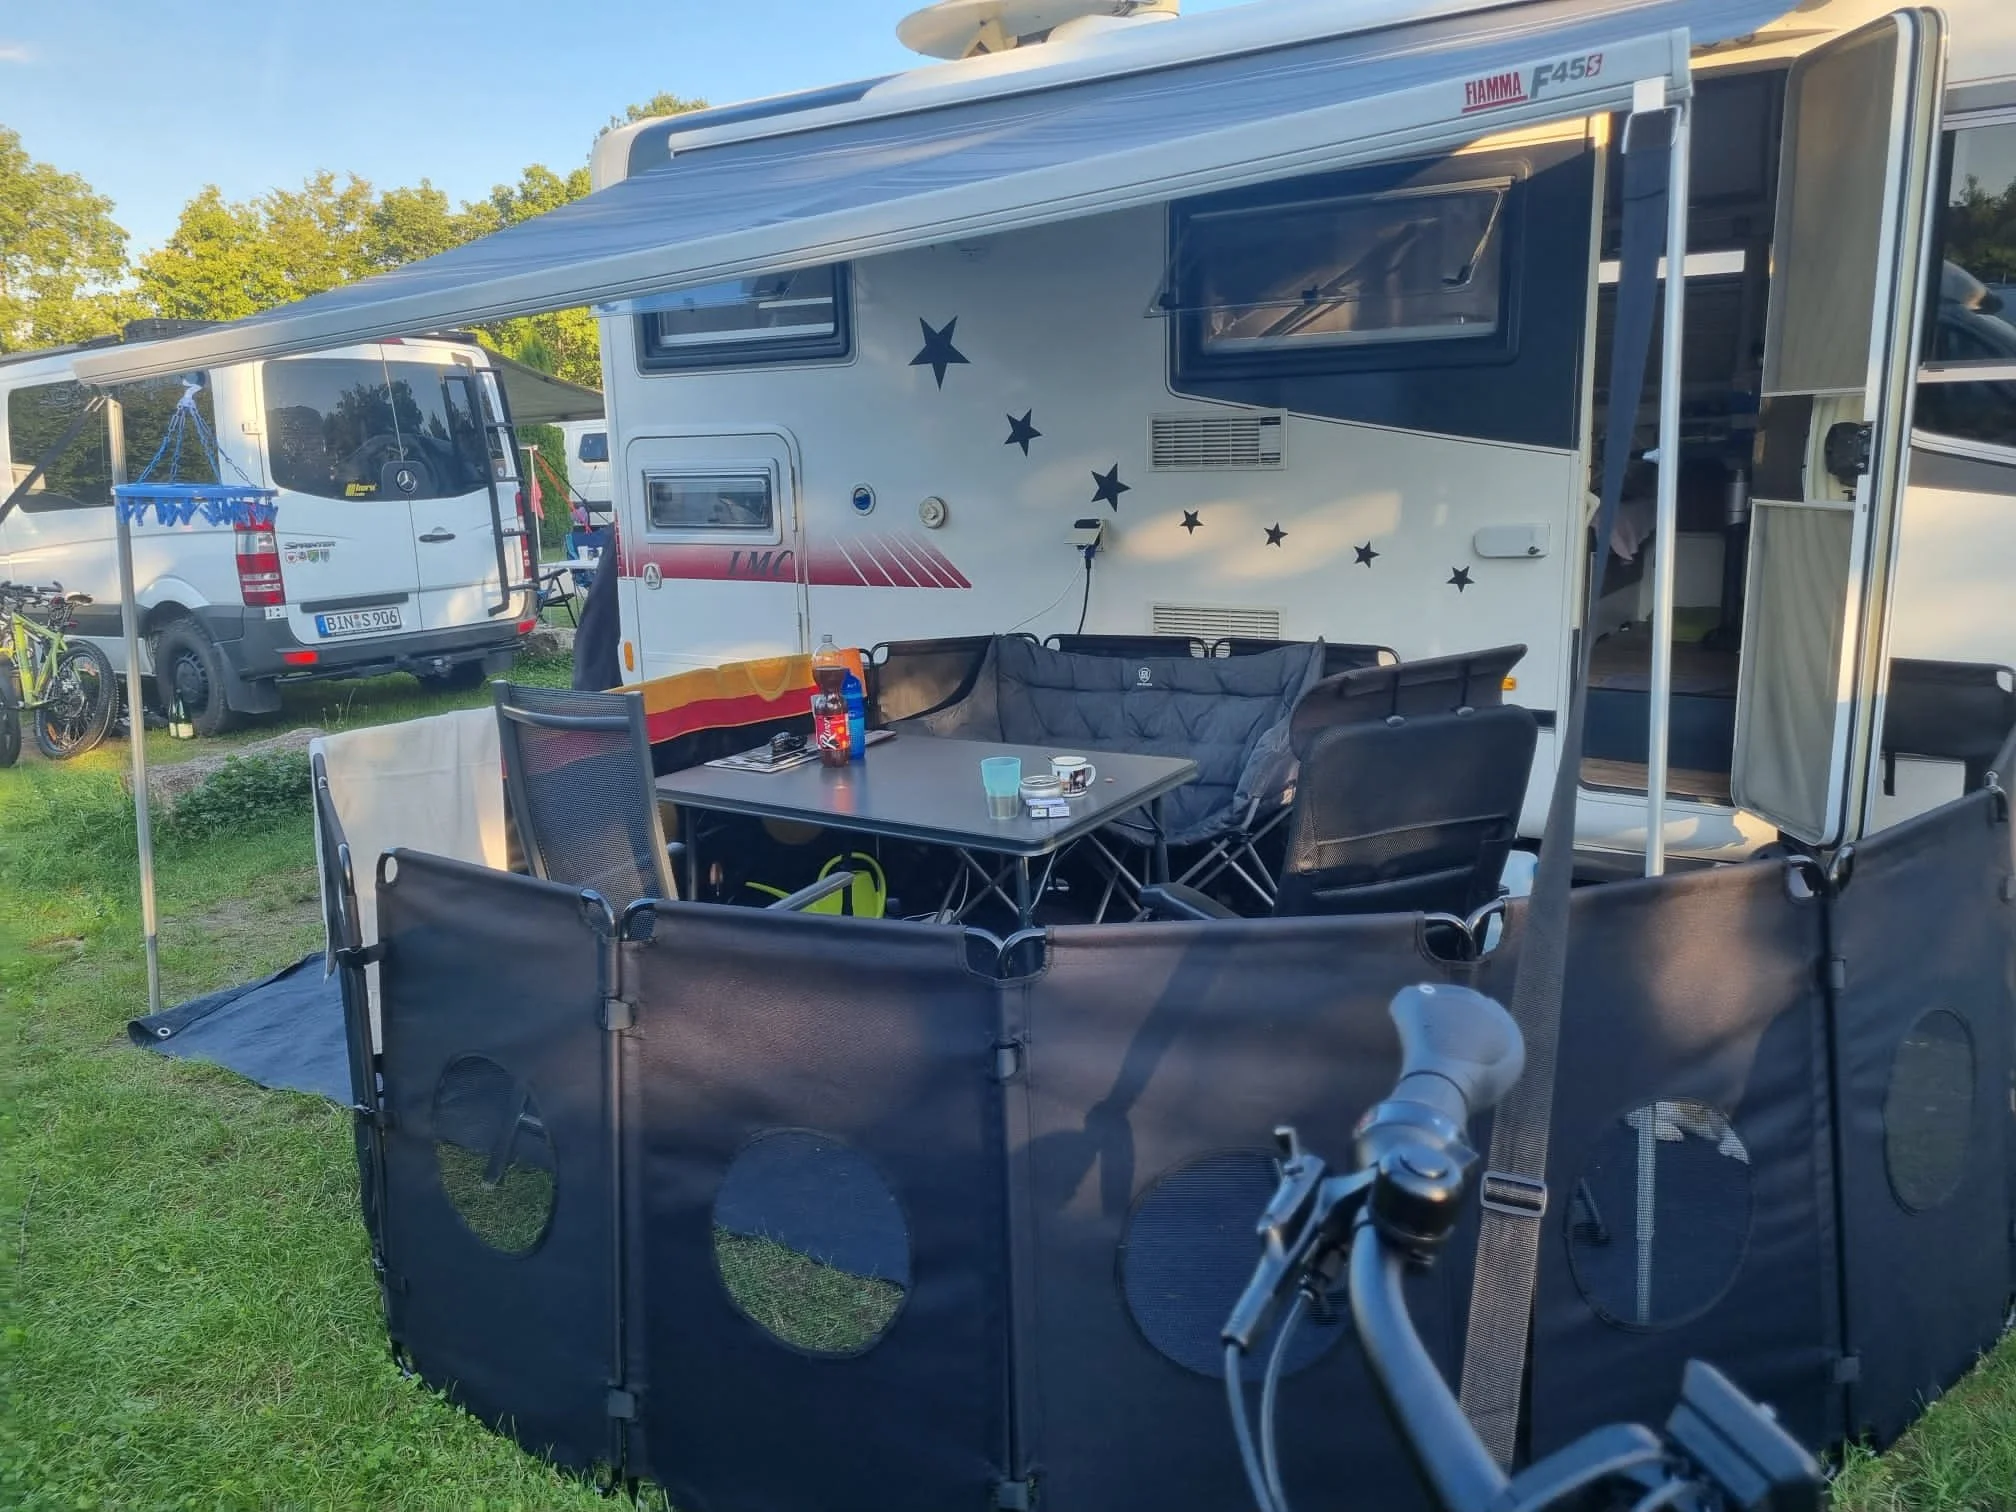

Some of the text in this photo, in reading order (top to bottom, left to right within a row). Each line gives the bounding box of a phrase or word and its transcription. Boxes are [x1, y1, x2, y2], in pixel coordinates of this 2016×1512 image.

[1465, 71, 1522, 105] FIAMMA
[728, 550, 794, 576] LMC
[326, 610, 398, 631] BIN S 906
